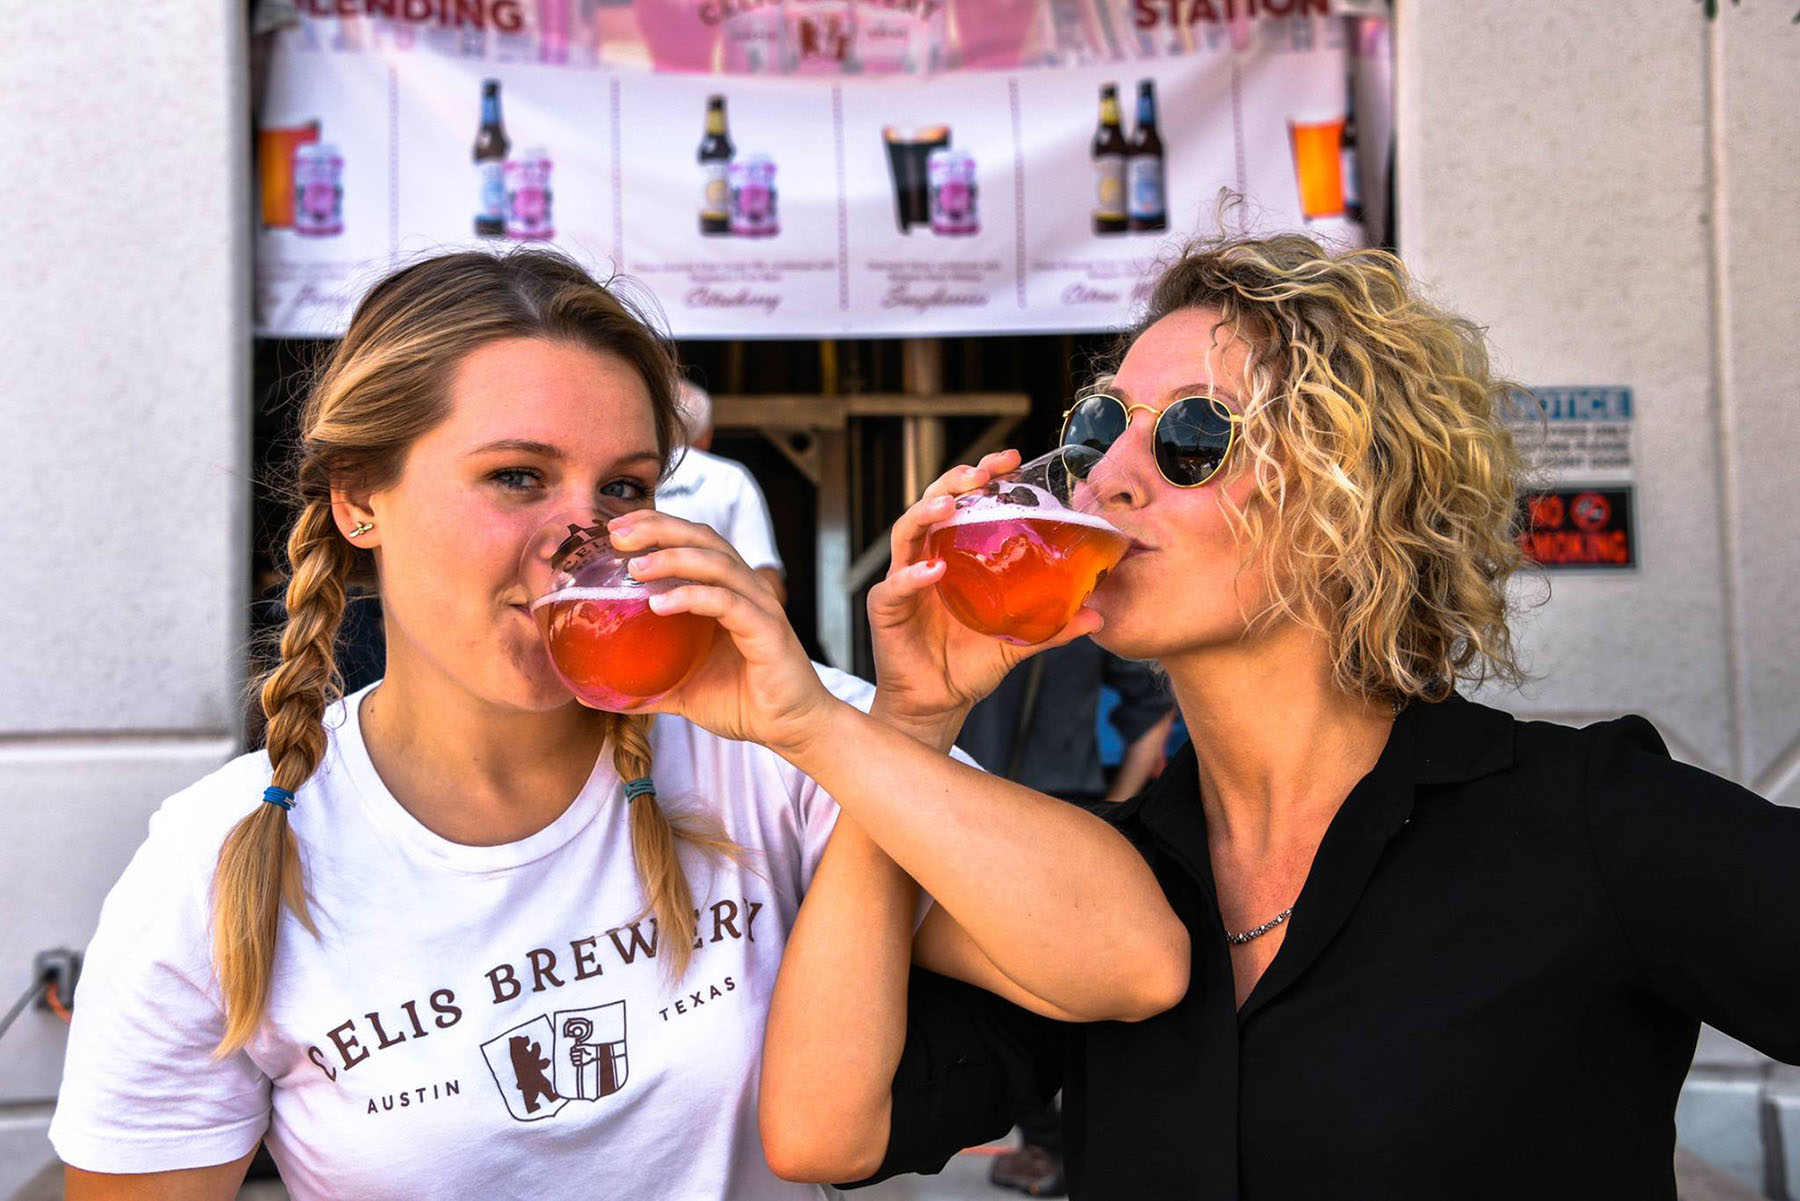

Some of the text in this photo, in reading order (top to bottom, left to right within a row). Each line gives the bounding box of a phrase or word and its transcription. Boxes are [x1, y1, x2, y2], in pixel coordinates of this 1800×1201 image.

[297, 0, 523, 32] LENDING
[308, 897, 763, 1082] CELIS BREWRY
[367, 976, 736, 1114] AUSTIN TEXAS
